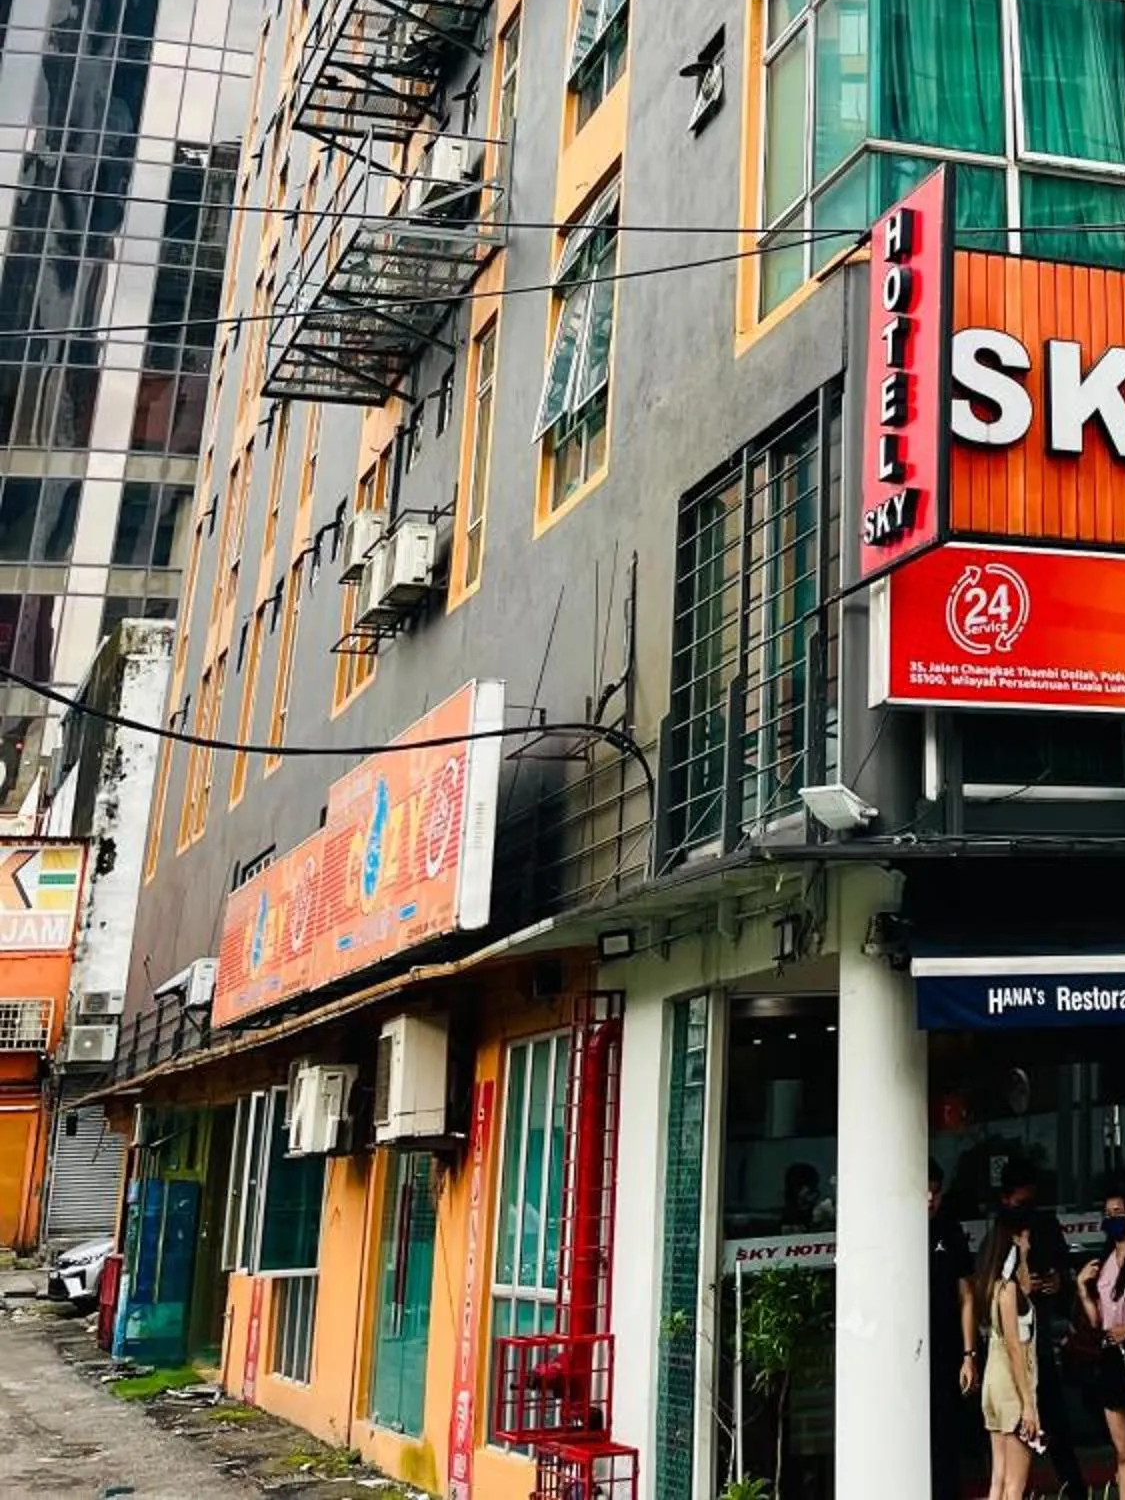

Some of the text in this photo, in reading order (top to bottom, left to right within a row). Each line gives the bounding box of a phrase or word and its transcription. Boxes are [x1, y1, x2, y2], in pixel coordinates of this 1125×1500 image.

[879, 207, 911, 483] HOTEL
[863, 489, 909, 545] SKY
[964, 584, 1012, 626] 24
[736, 1241, 837, 1262] SKY HOTE
